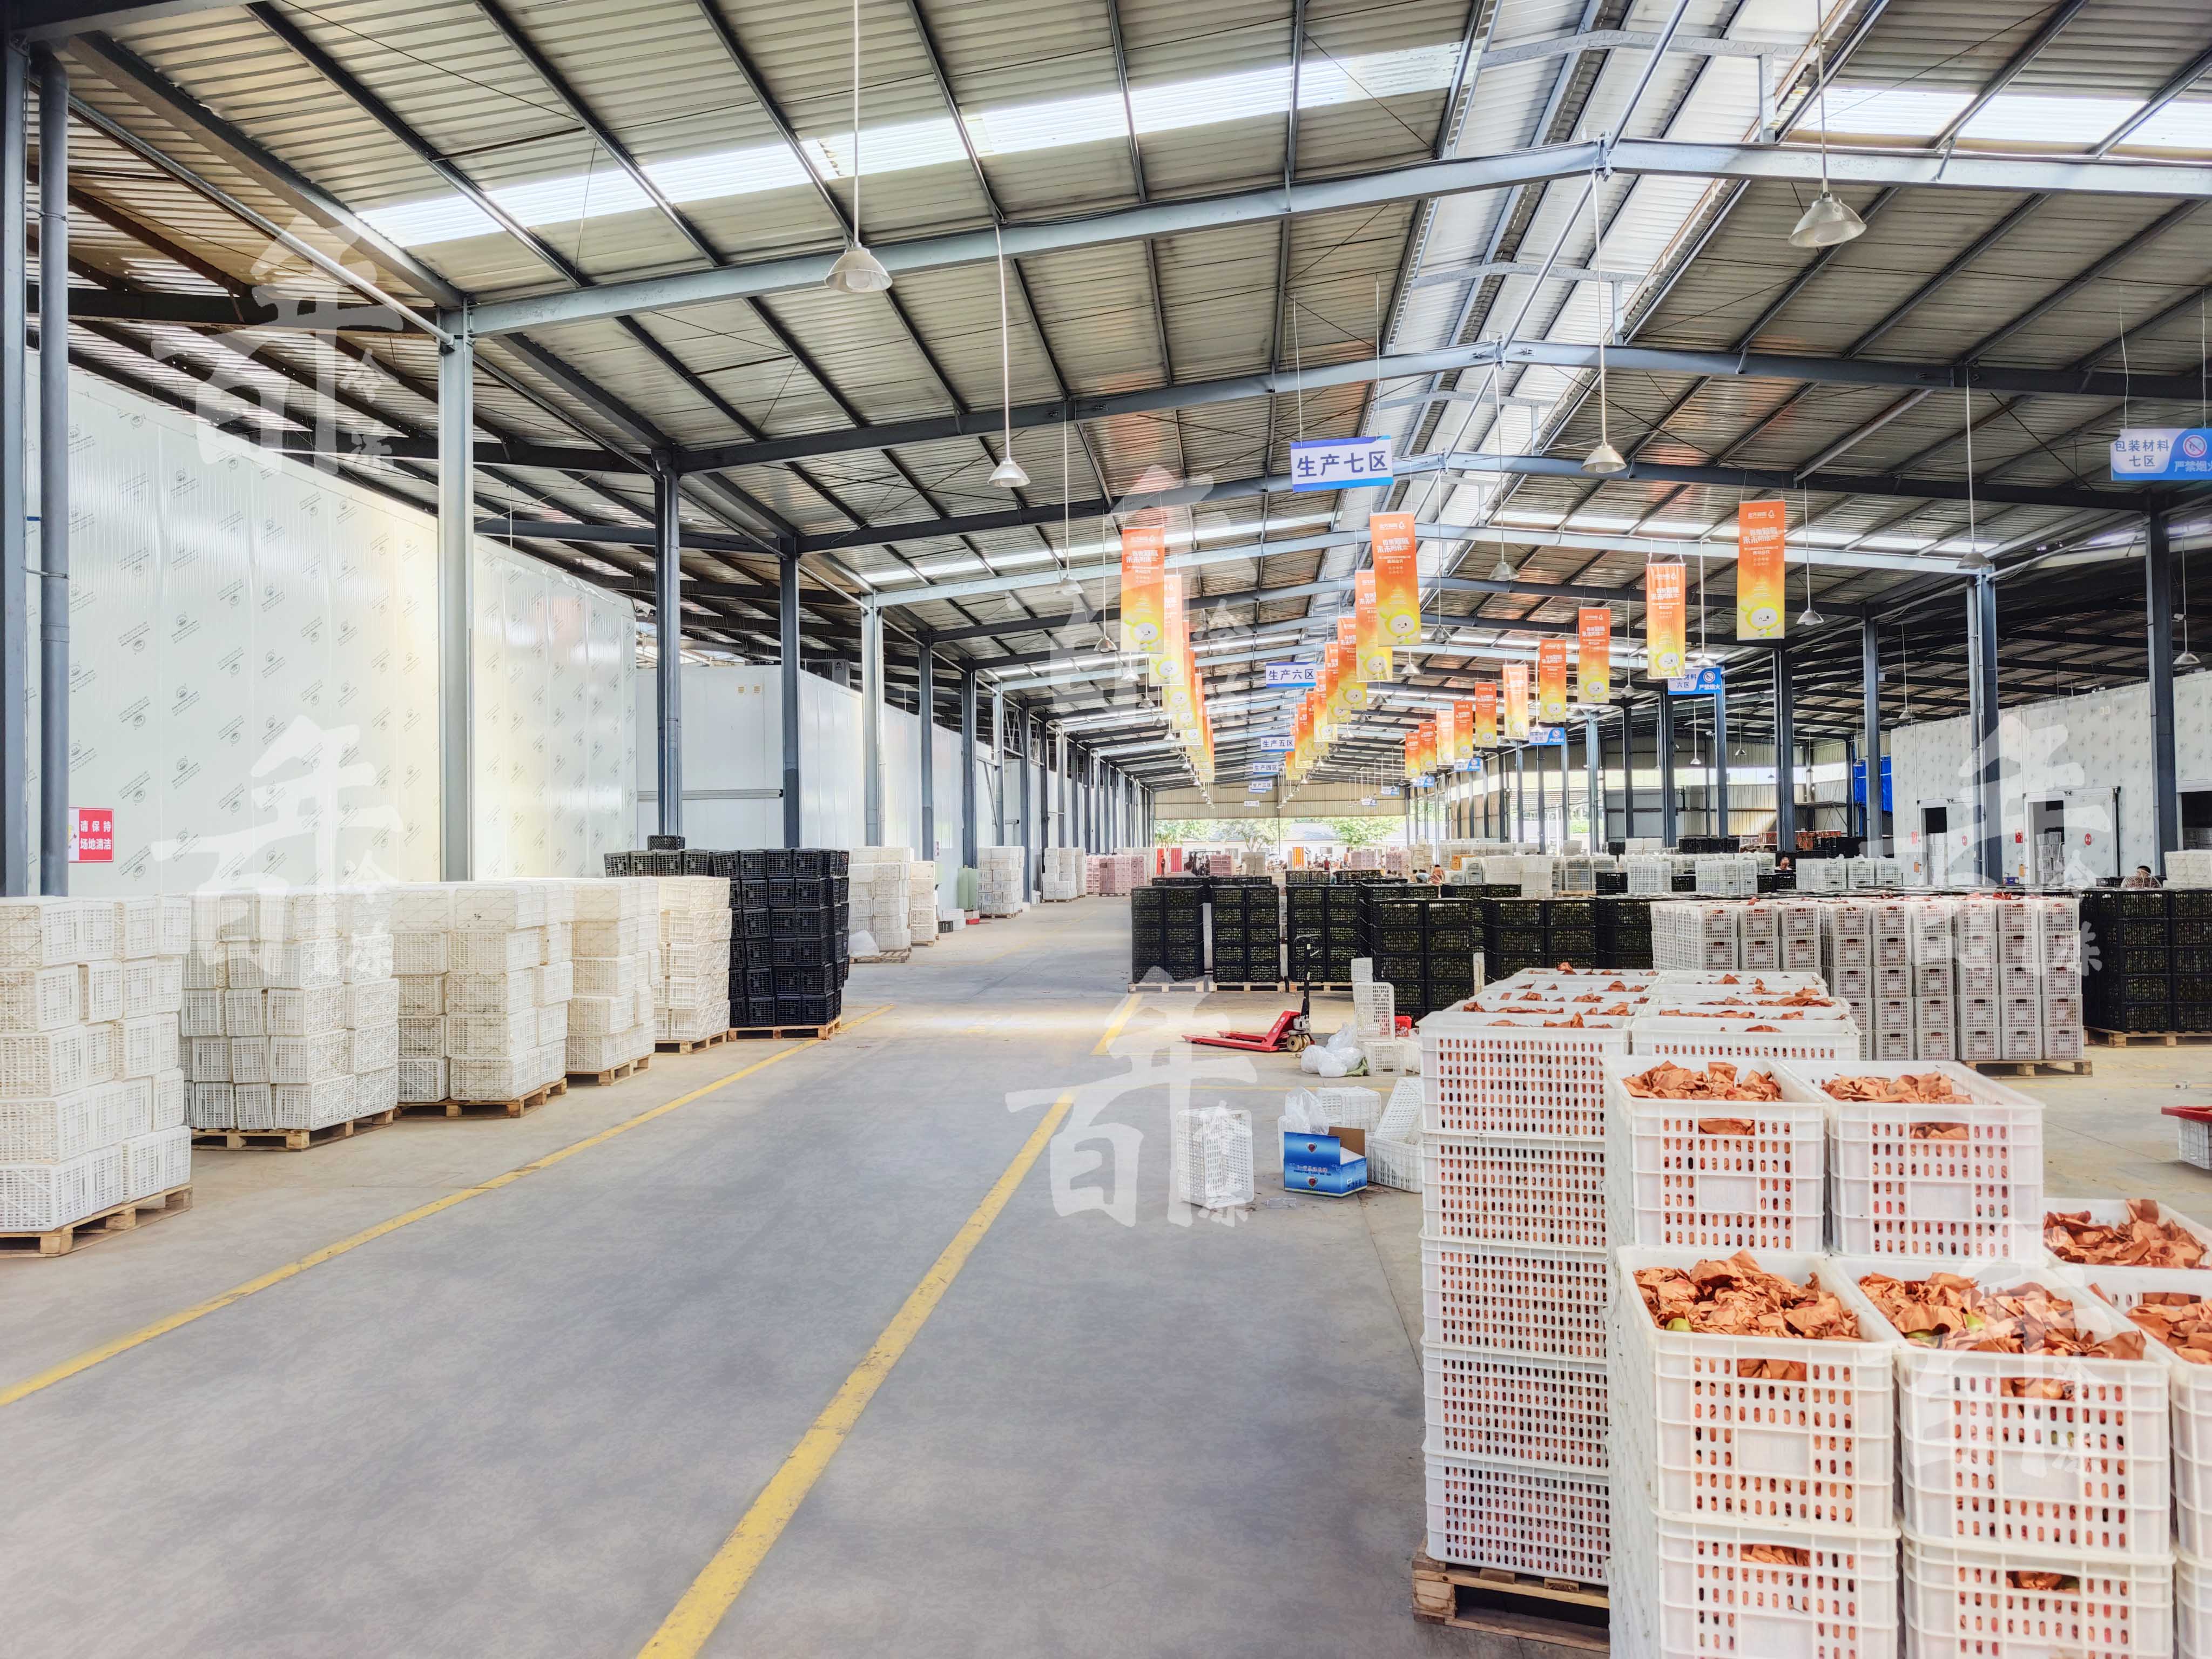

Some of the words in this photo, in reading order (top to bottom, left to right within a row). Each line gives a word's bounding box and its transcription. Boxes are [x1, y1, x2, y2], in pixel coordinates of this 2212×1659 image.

[2115, 440, 2169, 452] 包装材料
[1297, 450, 1387, 477] 生产七区
[2129, 455, 2155, 467] 七区
[1269, 669, 1313, 680] 生产六区
[80, 820, 112, 832] 请保持
[80, 838, 112, 850] 场地清洁
